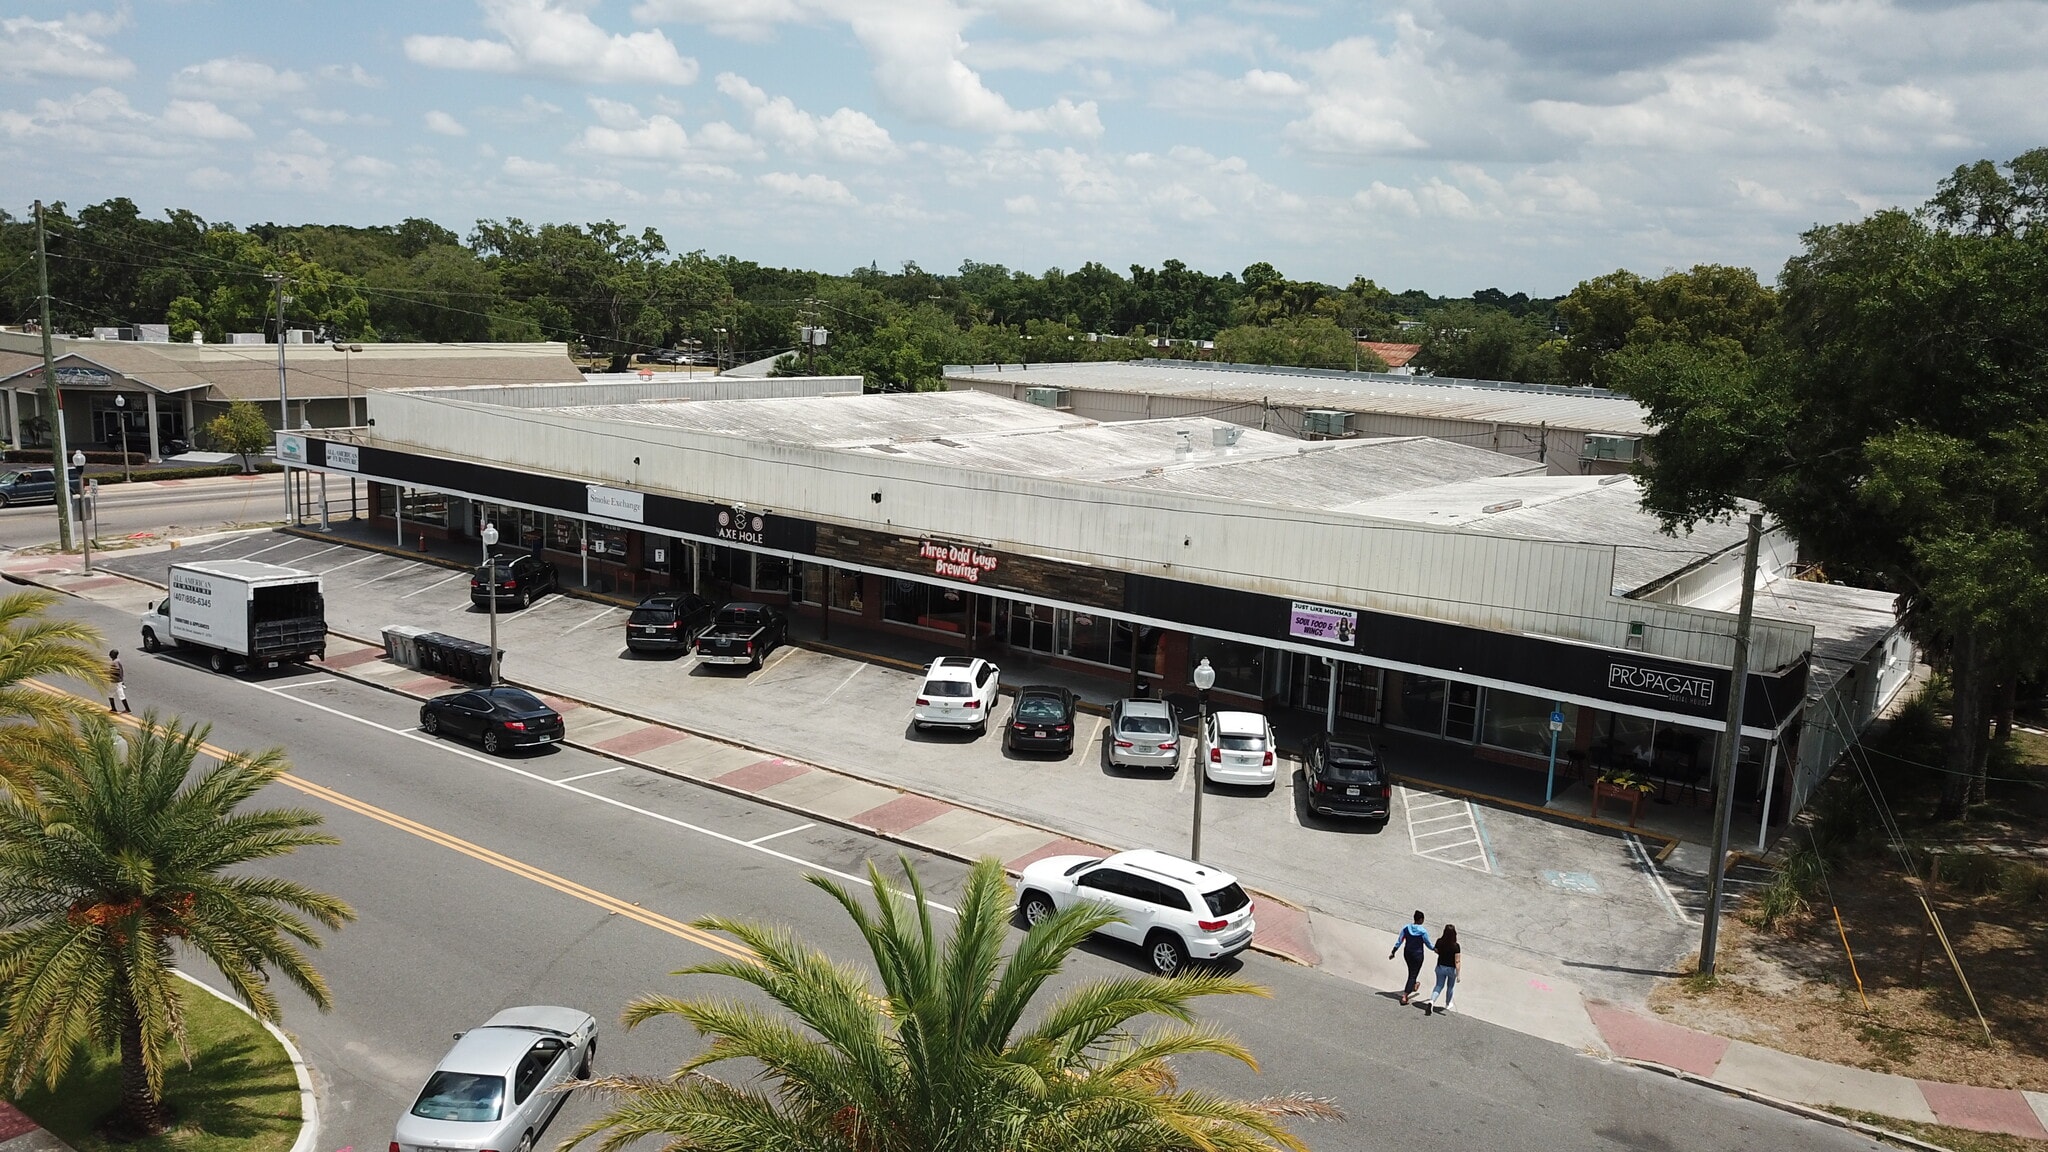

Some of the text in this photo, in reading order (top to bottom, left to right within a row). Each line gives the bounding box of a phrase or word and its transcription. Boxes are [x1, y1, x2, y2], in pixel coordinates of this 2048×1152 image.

[590, 493, 641, 512] Smoke Exchange
[718, 527, 763, 544] AXE HOLE
[920, 541, 998, 570] Three Odd Guys
[935, 559, 978, 581] Brewing
[173, 574, 212, 588] ALL AMERICAN
[173, 582, 212, 596] FURNITURE
[173, 592, 212, 608] (407)886-6345
[1324, 608, 1353, 618] MOMMAS
[1295, 616, 1310, 626] SOUL
[1311, 619, 1328, 629] FOOD
[1327, 623, 1334, 631] &
[1303, 626, 1324, 636] WINGS
[1611, 667, 1711, 698] PROPAGATE
[1668, 693, 1709, 707] SOCIAL HOUSE
